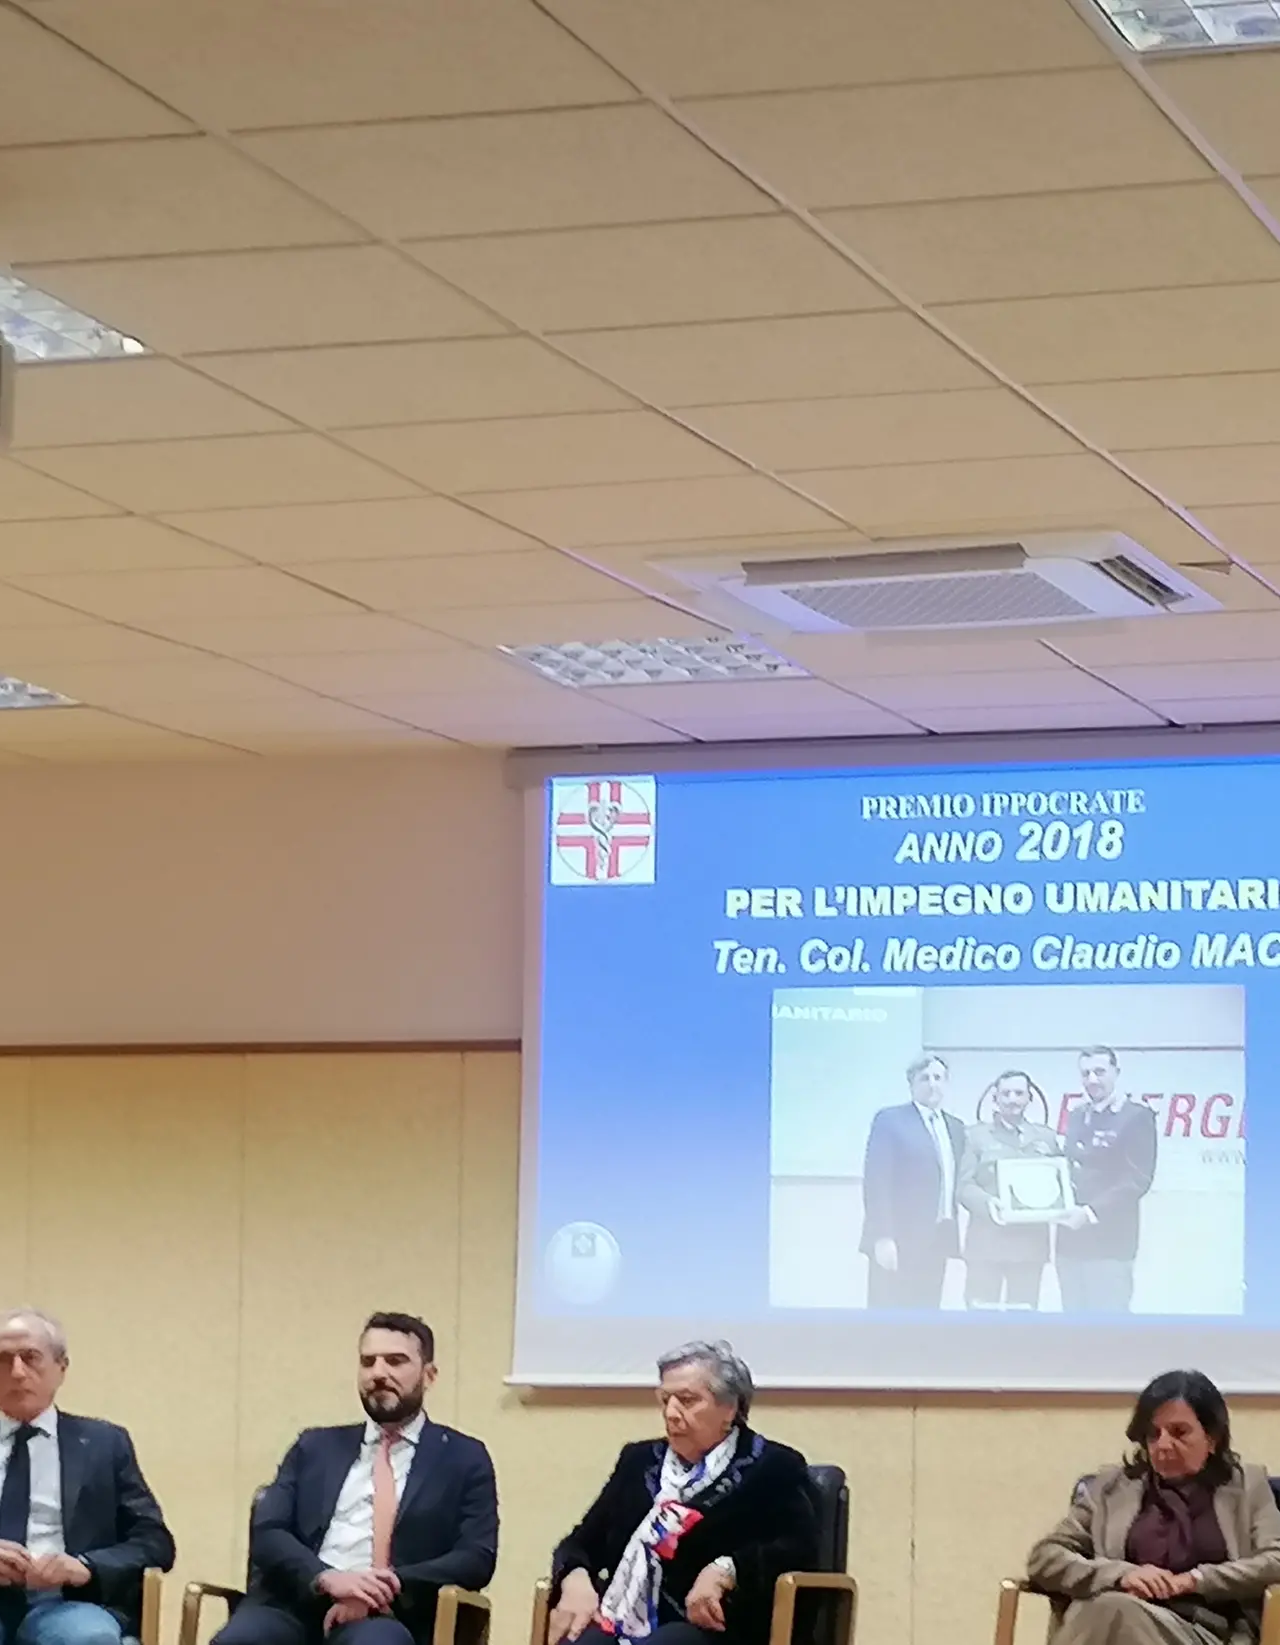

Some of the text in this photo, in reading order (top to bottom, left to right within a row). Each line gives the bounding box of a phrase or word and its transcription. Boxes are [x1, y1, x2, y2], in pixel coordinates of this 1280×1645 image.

[862, 789, 1146, 820] PREMIO IPPOCRATE
[894, 819, 1124, 864] ANNO 2018
[725, 887, 804, 918] PER
[712, 939, 787, 974] Ten.
[800, 937, 871, 974] Col.
[882, 935, 1021, 973] Medico
[1032, 932, 1181, 971] Claudio
